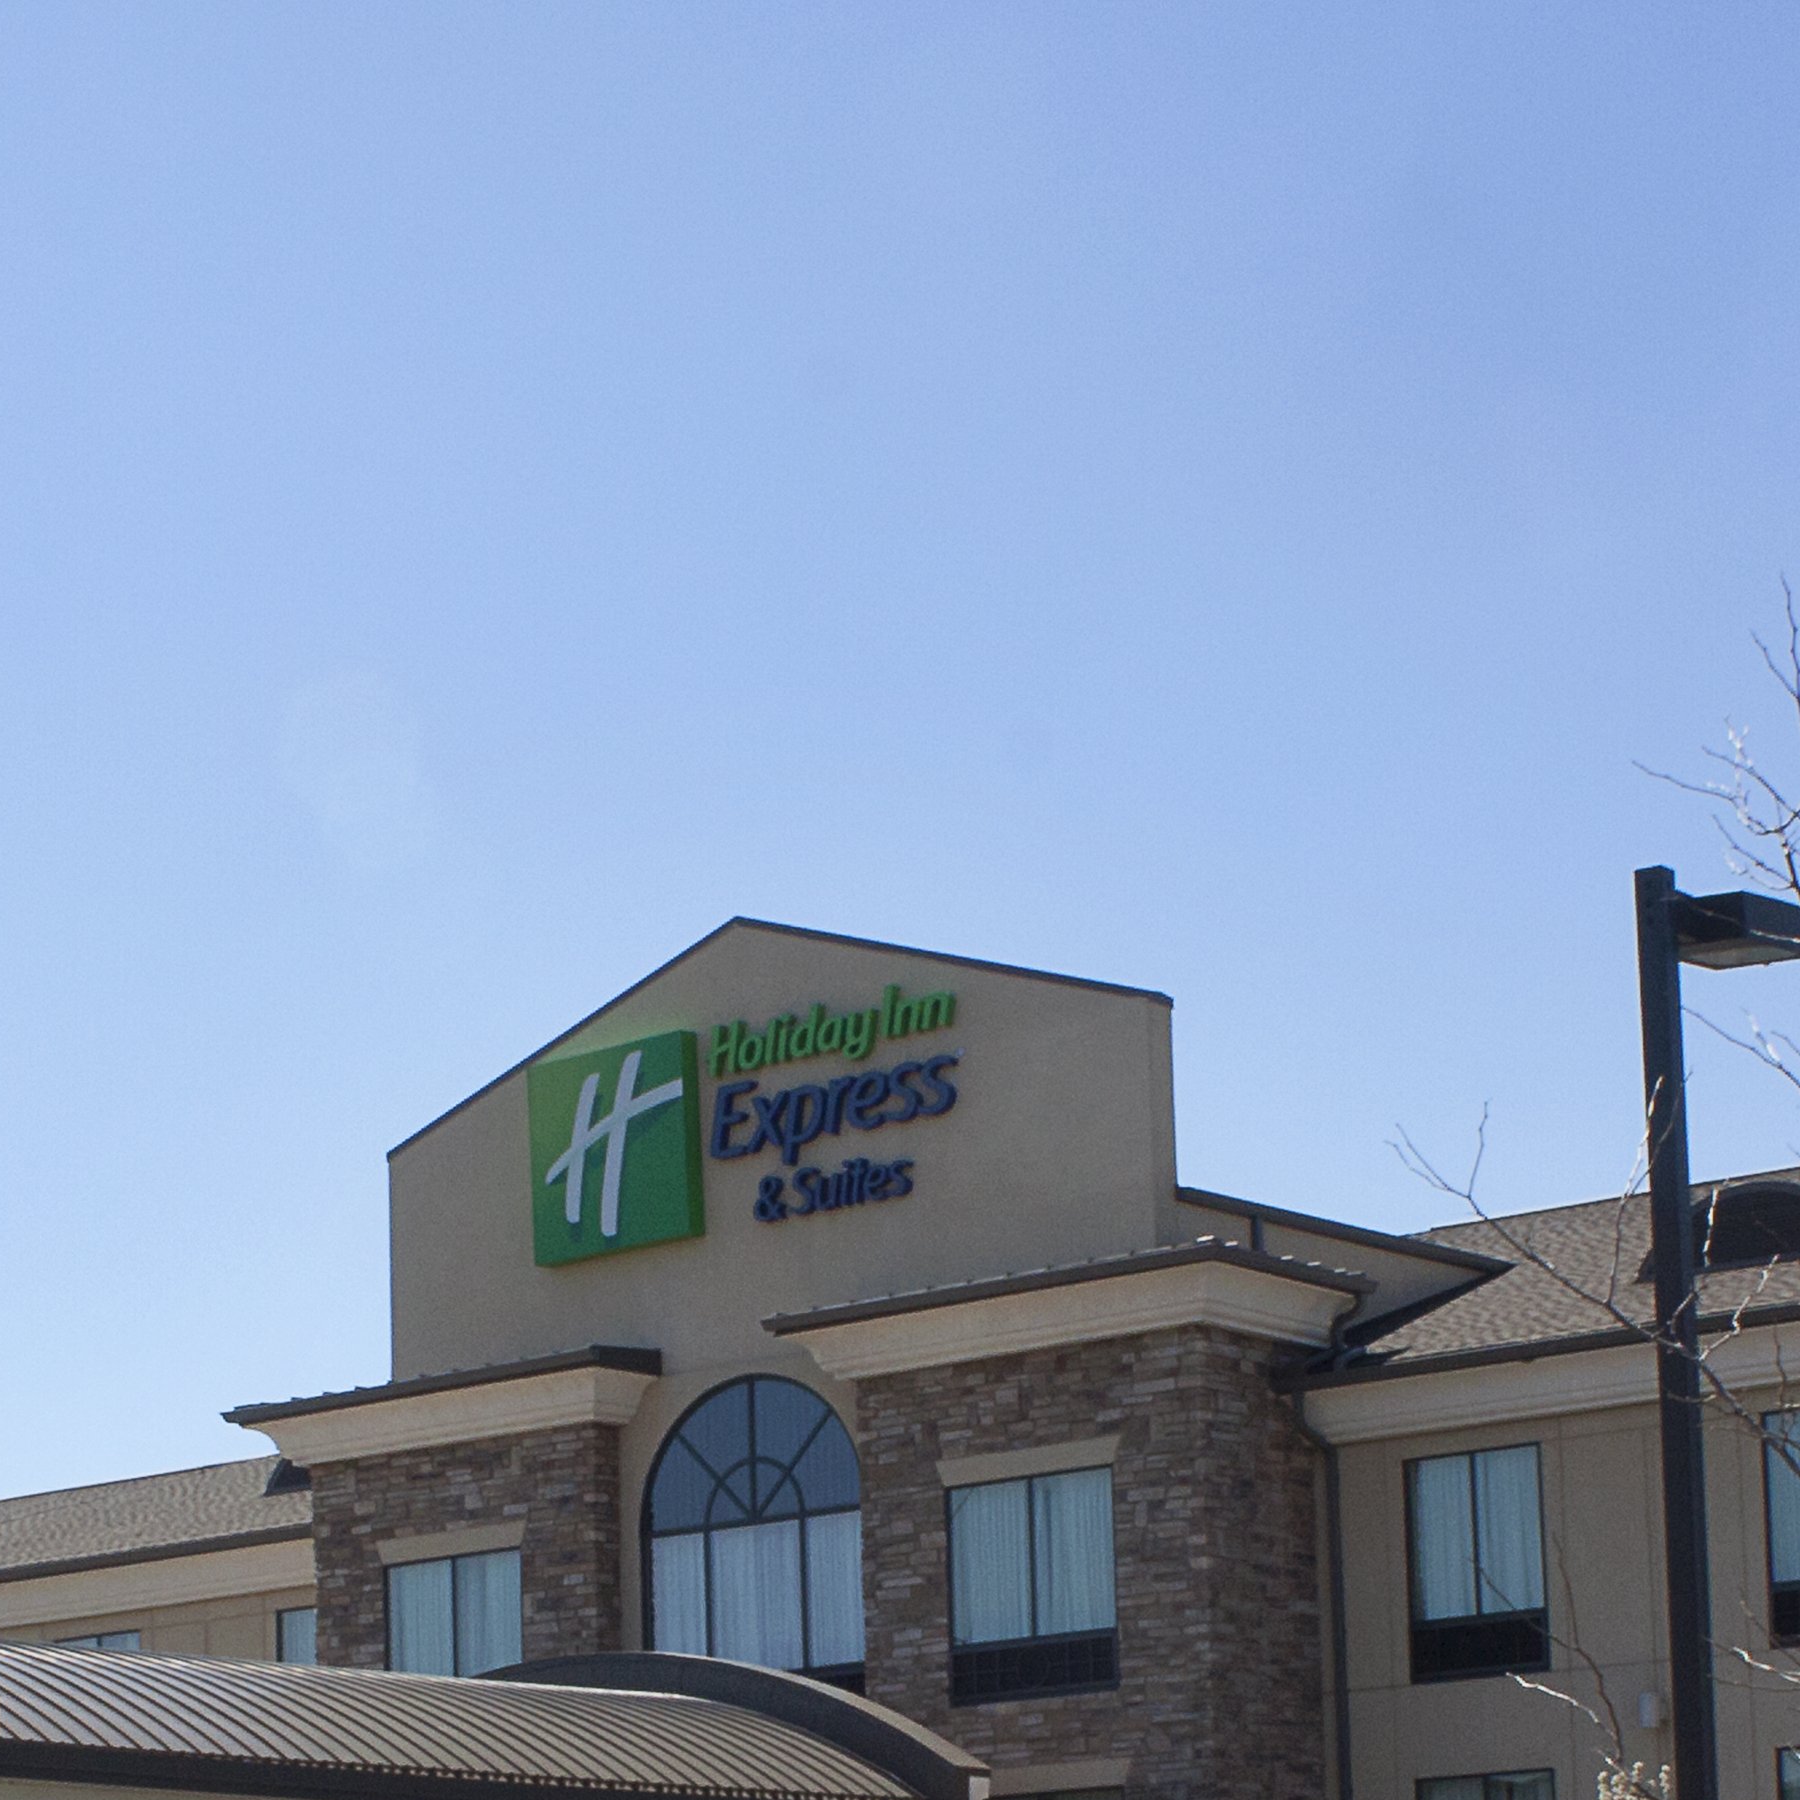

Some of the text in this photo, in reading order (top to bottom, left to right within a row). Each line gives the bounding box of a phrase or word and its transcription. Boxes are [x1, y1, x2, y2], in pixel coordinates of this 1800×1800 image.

[707, 983, 956, 1078] Holiday Inn
[709, 1054, 959, 1167] Express
[753, 1157, 915, 1222] & Suites
